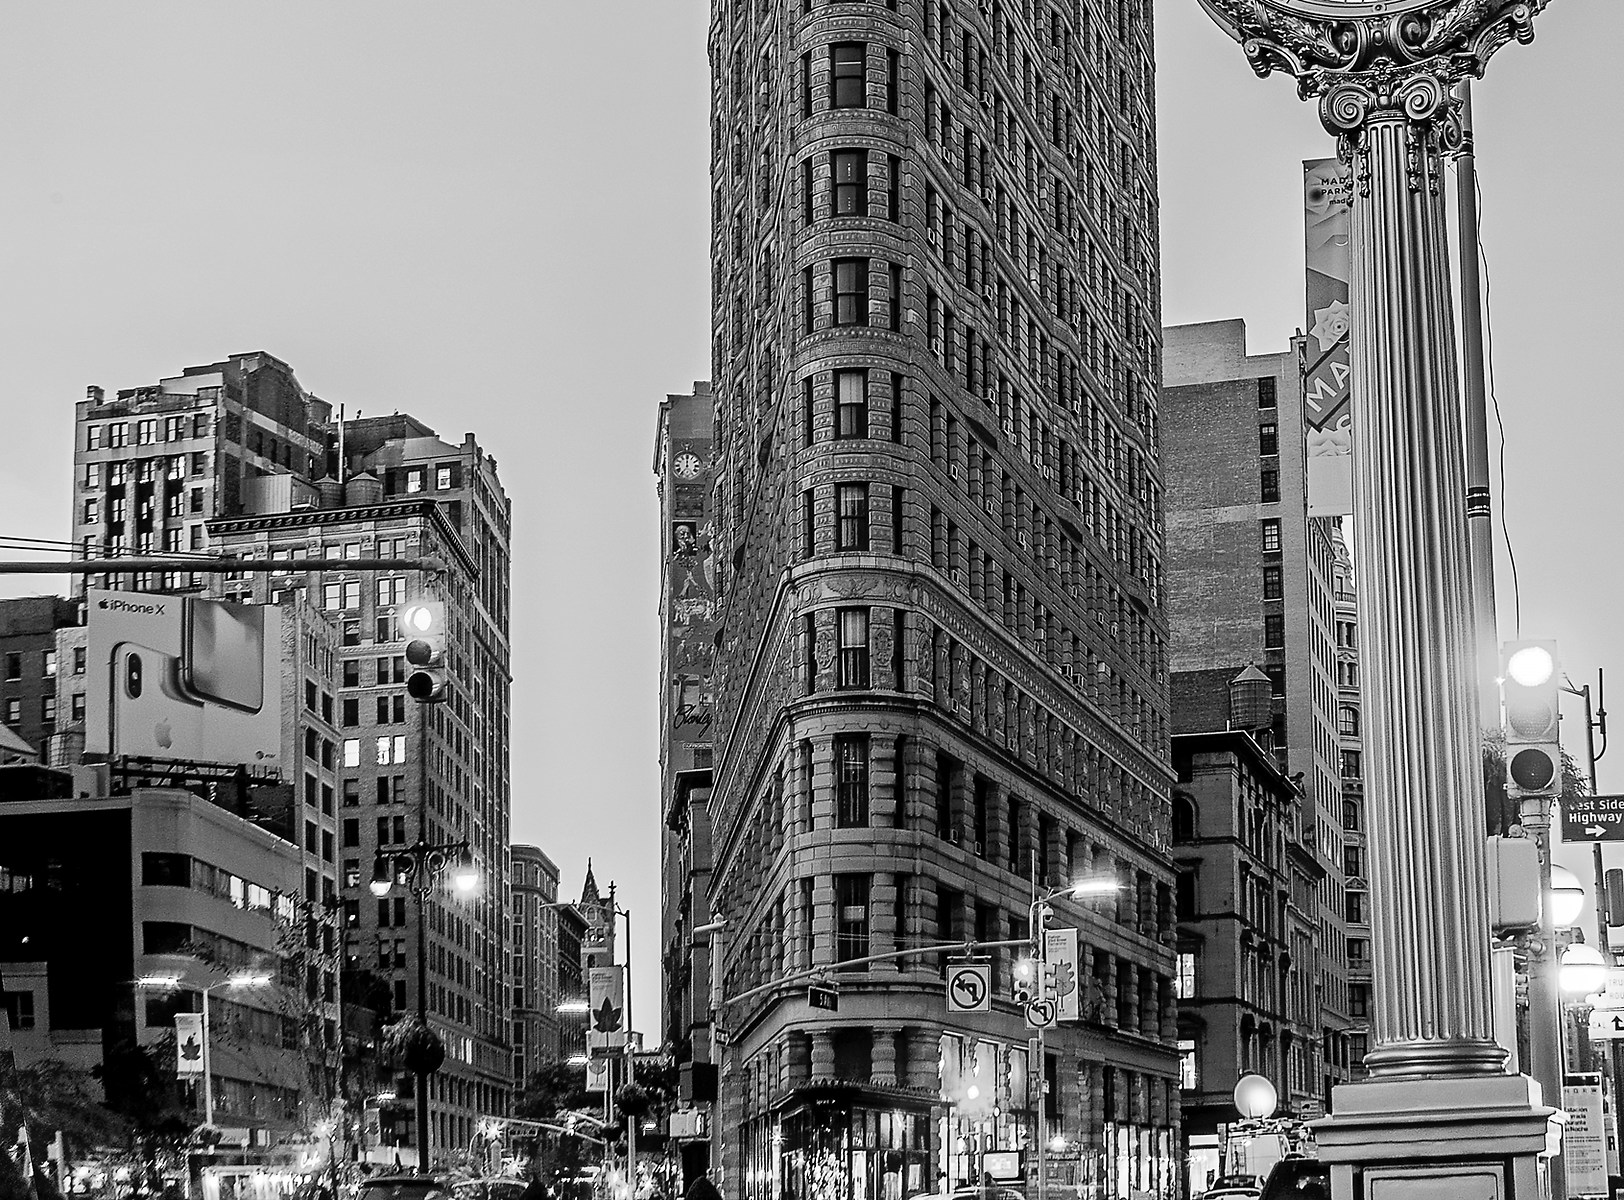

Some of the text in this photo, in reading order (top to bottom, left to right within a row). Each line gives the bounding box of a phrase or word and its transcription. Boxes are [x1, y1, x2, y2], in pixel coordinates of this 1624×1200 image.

[1321, 187, 1349, 195] PARK
[110, 599, 166, 615] iPhone X
[1599, 799, 1624, 810] Side
[1569, 812, 1623, 825] Highway
